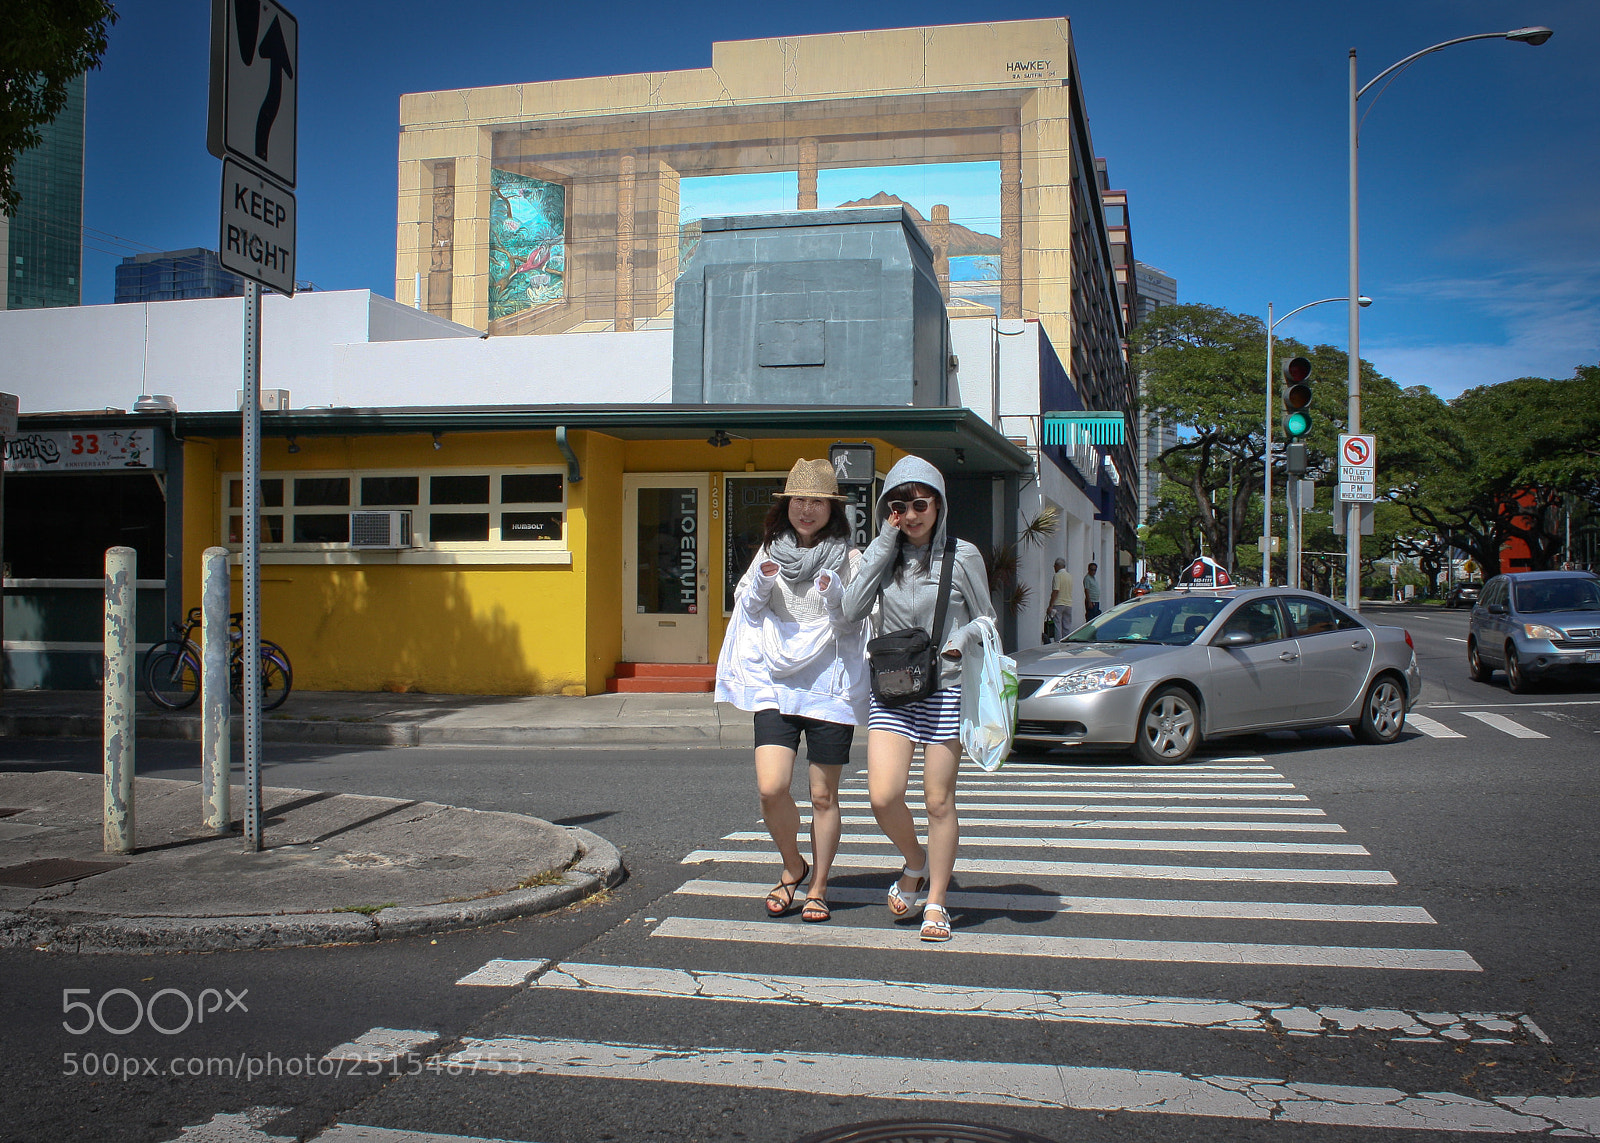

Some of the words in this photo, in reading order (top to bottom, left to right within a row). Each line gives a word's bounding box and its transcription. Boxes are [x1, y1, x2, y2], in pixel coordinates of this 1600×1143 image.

[1006, 60, 1051, 71] HAWKEY
[235, 183, 286, 229] KEEP
[227, 223, 290, 274] RIGHT
[71, 434, 100, 455] 33
[711, 475, 719, 519] 1299
[744, 488, 777, 504] OPE
